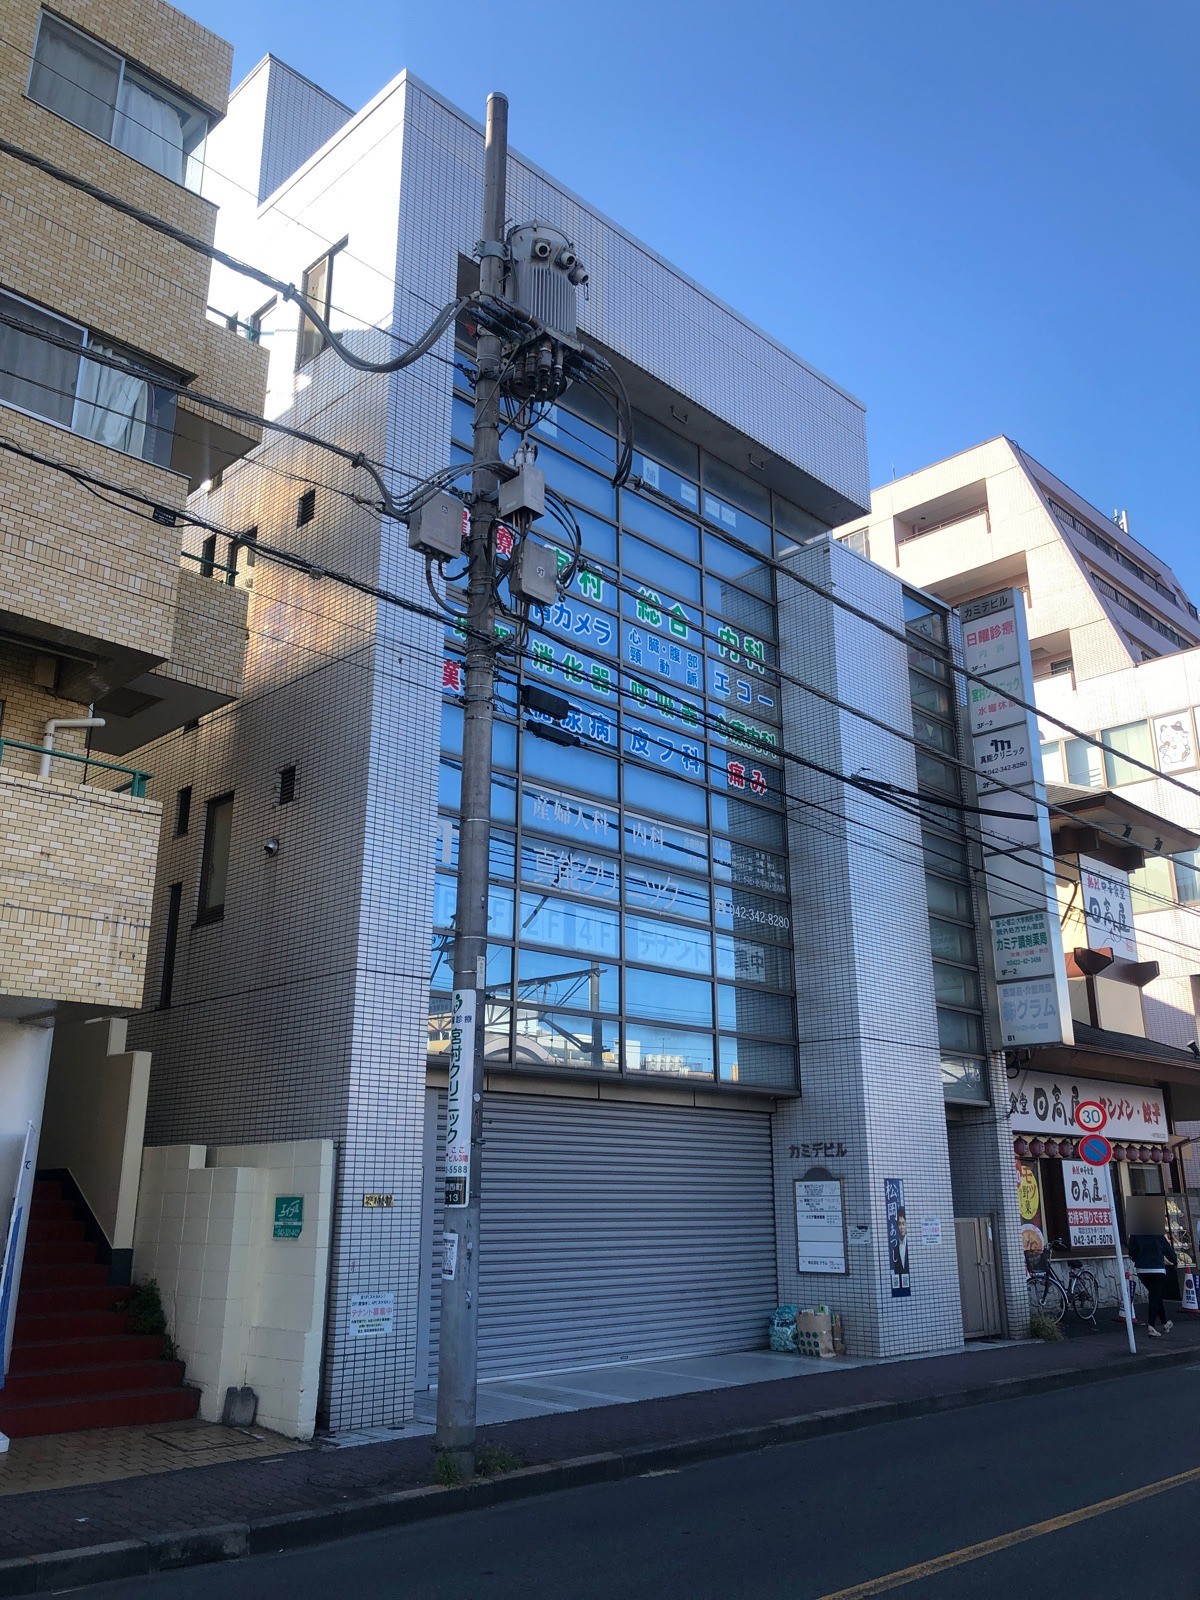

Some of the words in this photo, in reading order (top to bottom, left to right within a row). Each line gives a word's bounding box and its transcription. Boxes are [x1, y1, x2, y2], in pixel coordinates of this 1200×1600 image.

[636, 587, 690, 640] 総合
[717, 625, 766, 675] 内科
[966, 620, 1014, 648] 日曜診療
[531, 639, 612, 696] 消化器
[714, 671, 774, 708] エコー
[629, 727, 701, 774] 皮フ科
[714, 714, 778, 760] 心療内科
[727, 761, 768, 797] 痛み
[987, 761, 1028, 776] 042-342-8280
[532, 794, 609, 837] 産婦人科
[632, 821, 664, 852] 内科
[533, 846, 680, 910] 真能クリニック
[730, 904, 790, 930] 042-342-8280
[1088, 896, 1131, 933] 日高屋
[579, 920, 613, 950] 4F
[1007, 1034, 1016, 1042] B1
[446, 1027, 463, 1145] 宮村クリニック
[1082, 1109, 1101, 1124] 30
[1071, 1177, 1103, 1204] 日高屋
